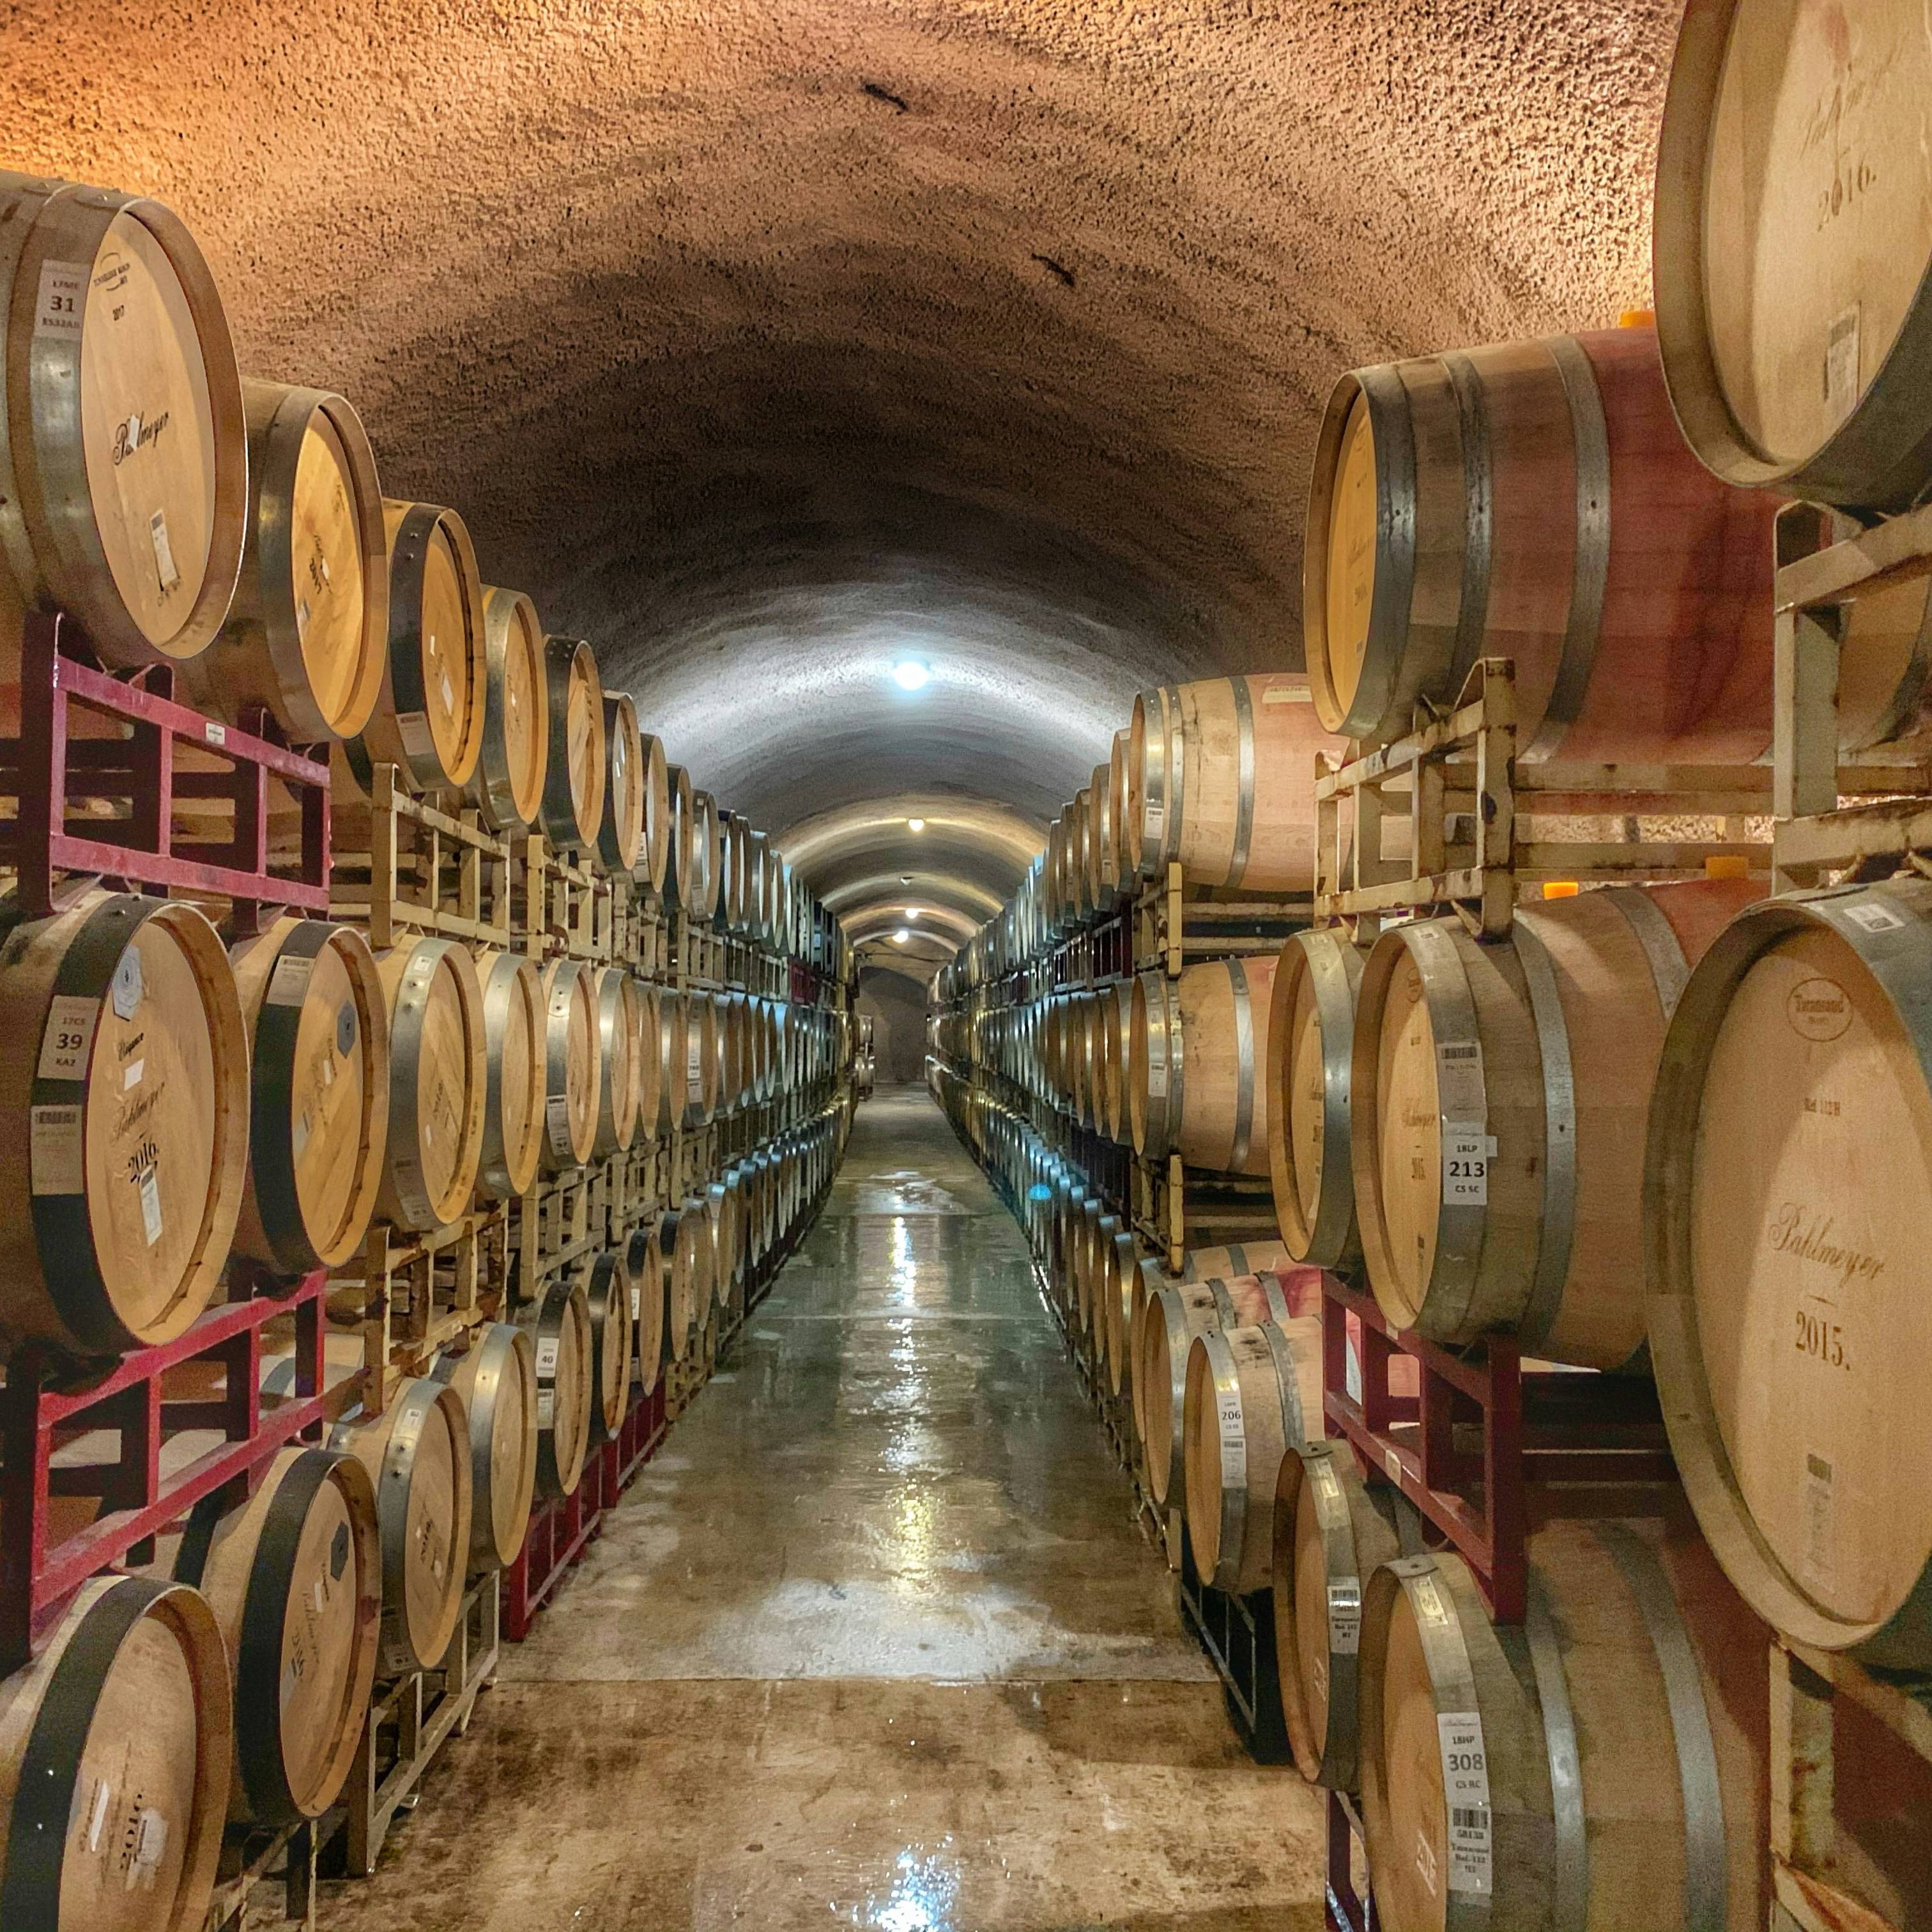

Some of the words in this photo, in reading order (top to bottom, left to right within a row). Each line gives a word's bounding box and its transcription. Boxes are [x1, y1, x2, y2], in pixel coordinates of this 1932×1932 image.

[50, 295, 75, 312] 31
[113, 411, 169, 466] Palmeyer
[56, 1032, 83, 1050] 39
[1449, 1161, 1485, 1177] 213
[1768, 1202, 1884, 1289] Pahlmeyer
[1796, 1310, 1851, 1372] 2015.
[542, 1355, 554, 1364] 40
[1222, 1410, 1241, 1421] 206
[1448, 1753, 1483, 1772] 308
